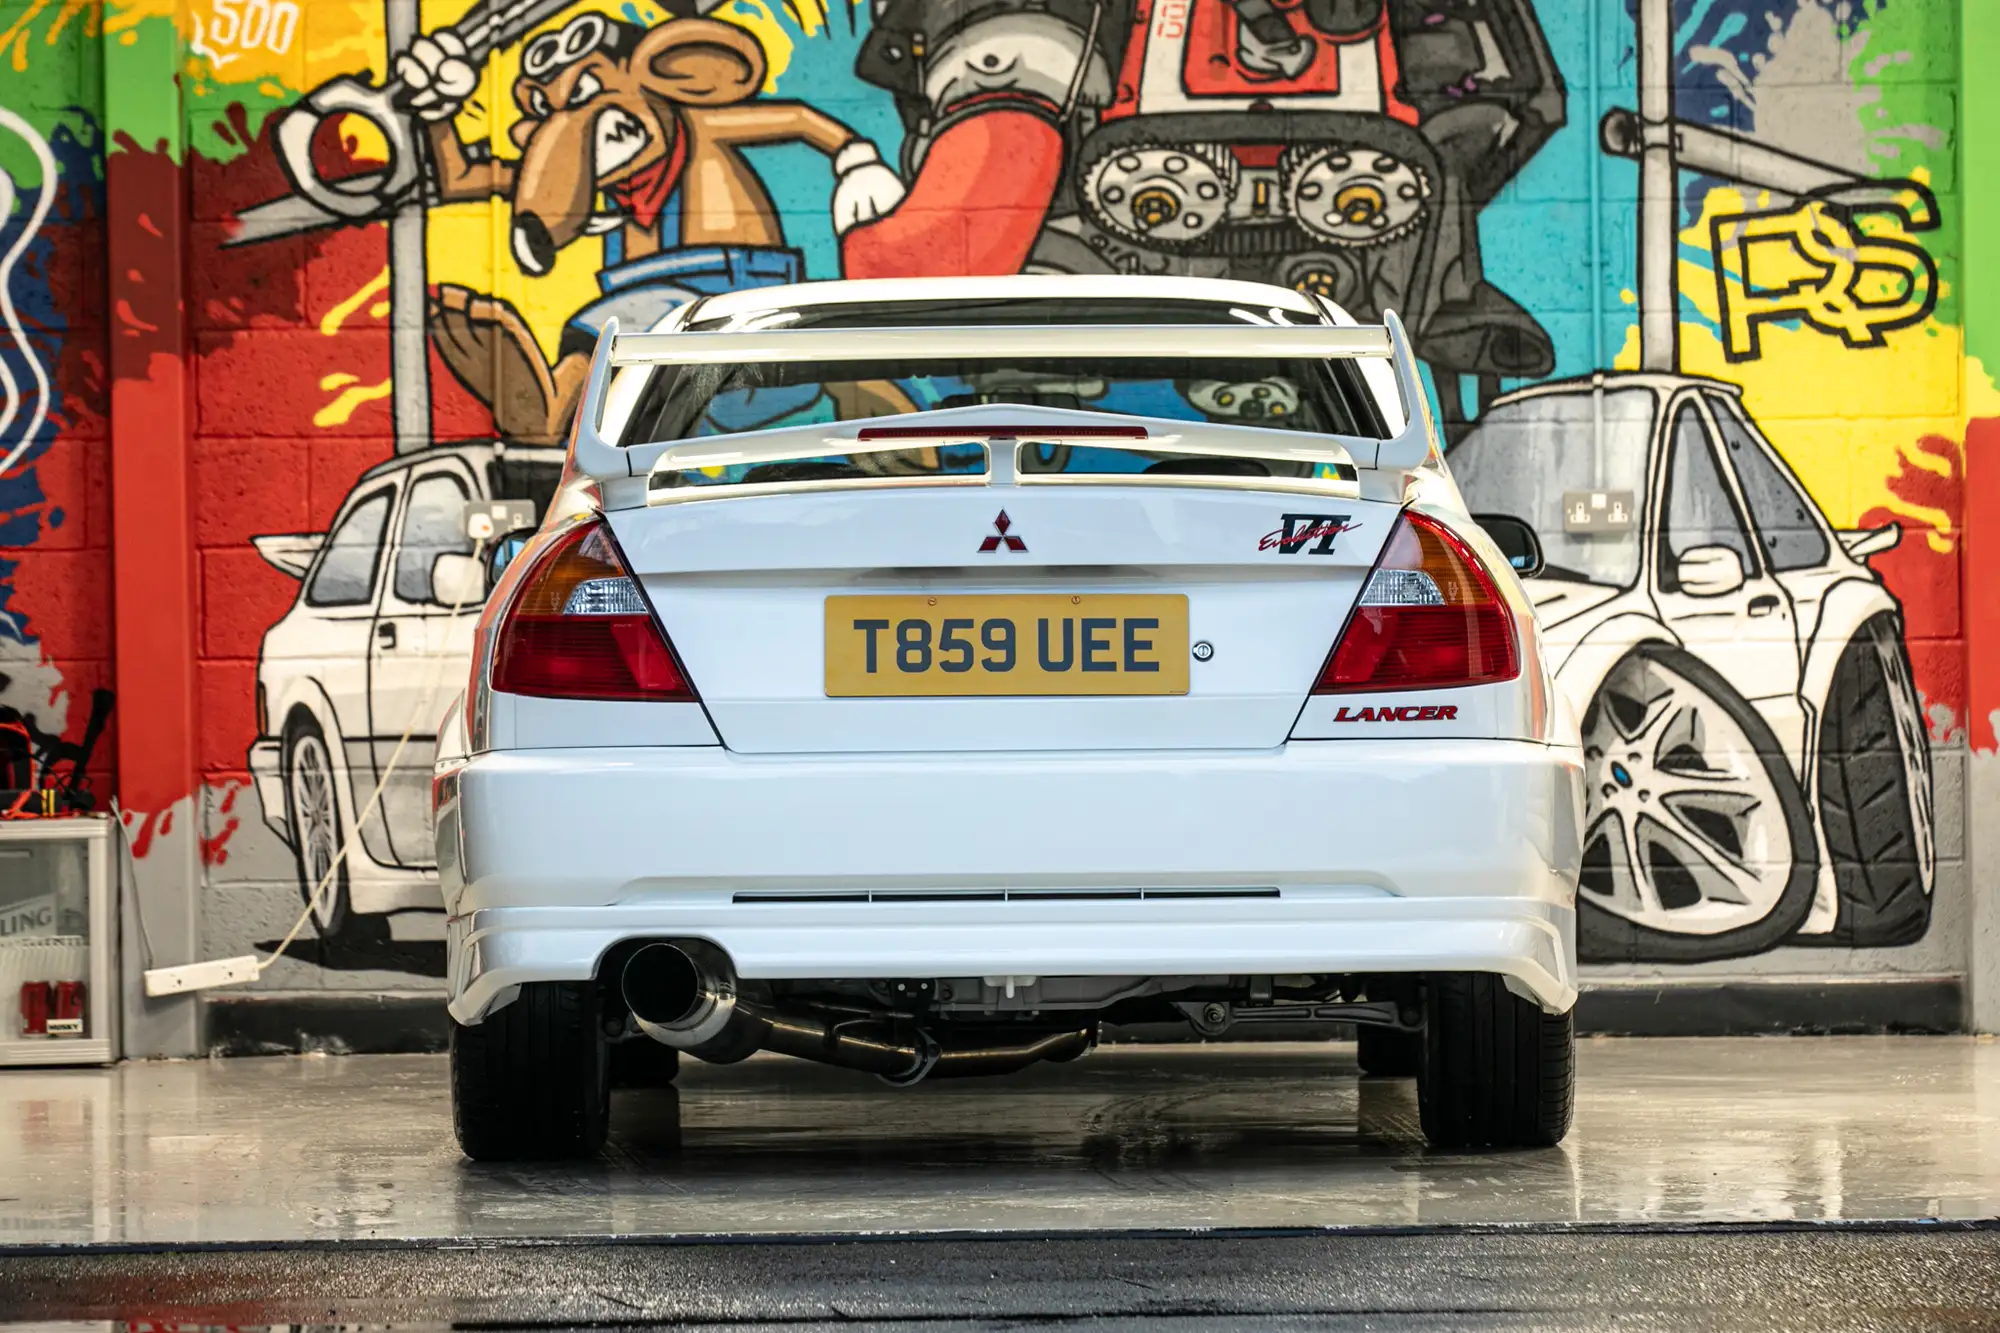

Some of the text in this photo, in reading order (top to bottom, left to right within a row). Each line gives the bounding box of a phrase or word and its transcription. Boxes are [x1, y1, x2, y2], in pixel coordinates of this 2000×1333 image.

[211, 0, 300, 55] 500
[1258, 513, 1364, 555] Evolution VI
[853, 618, 1160, 673] T859 UEE
[1333, 705, 1459, 722] LANCER
